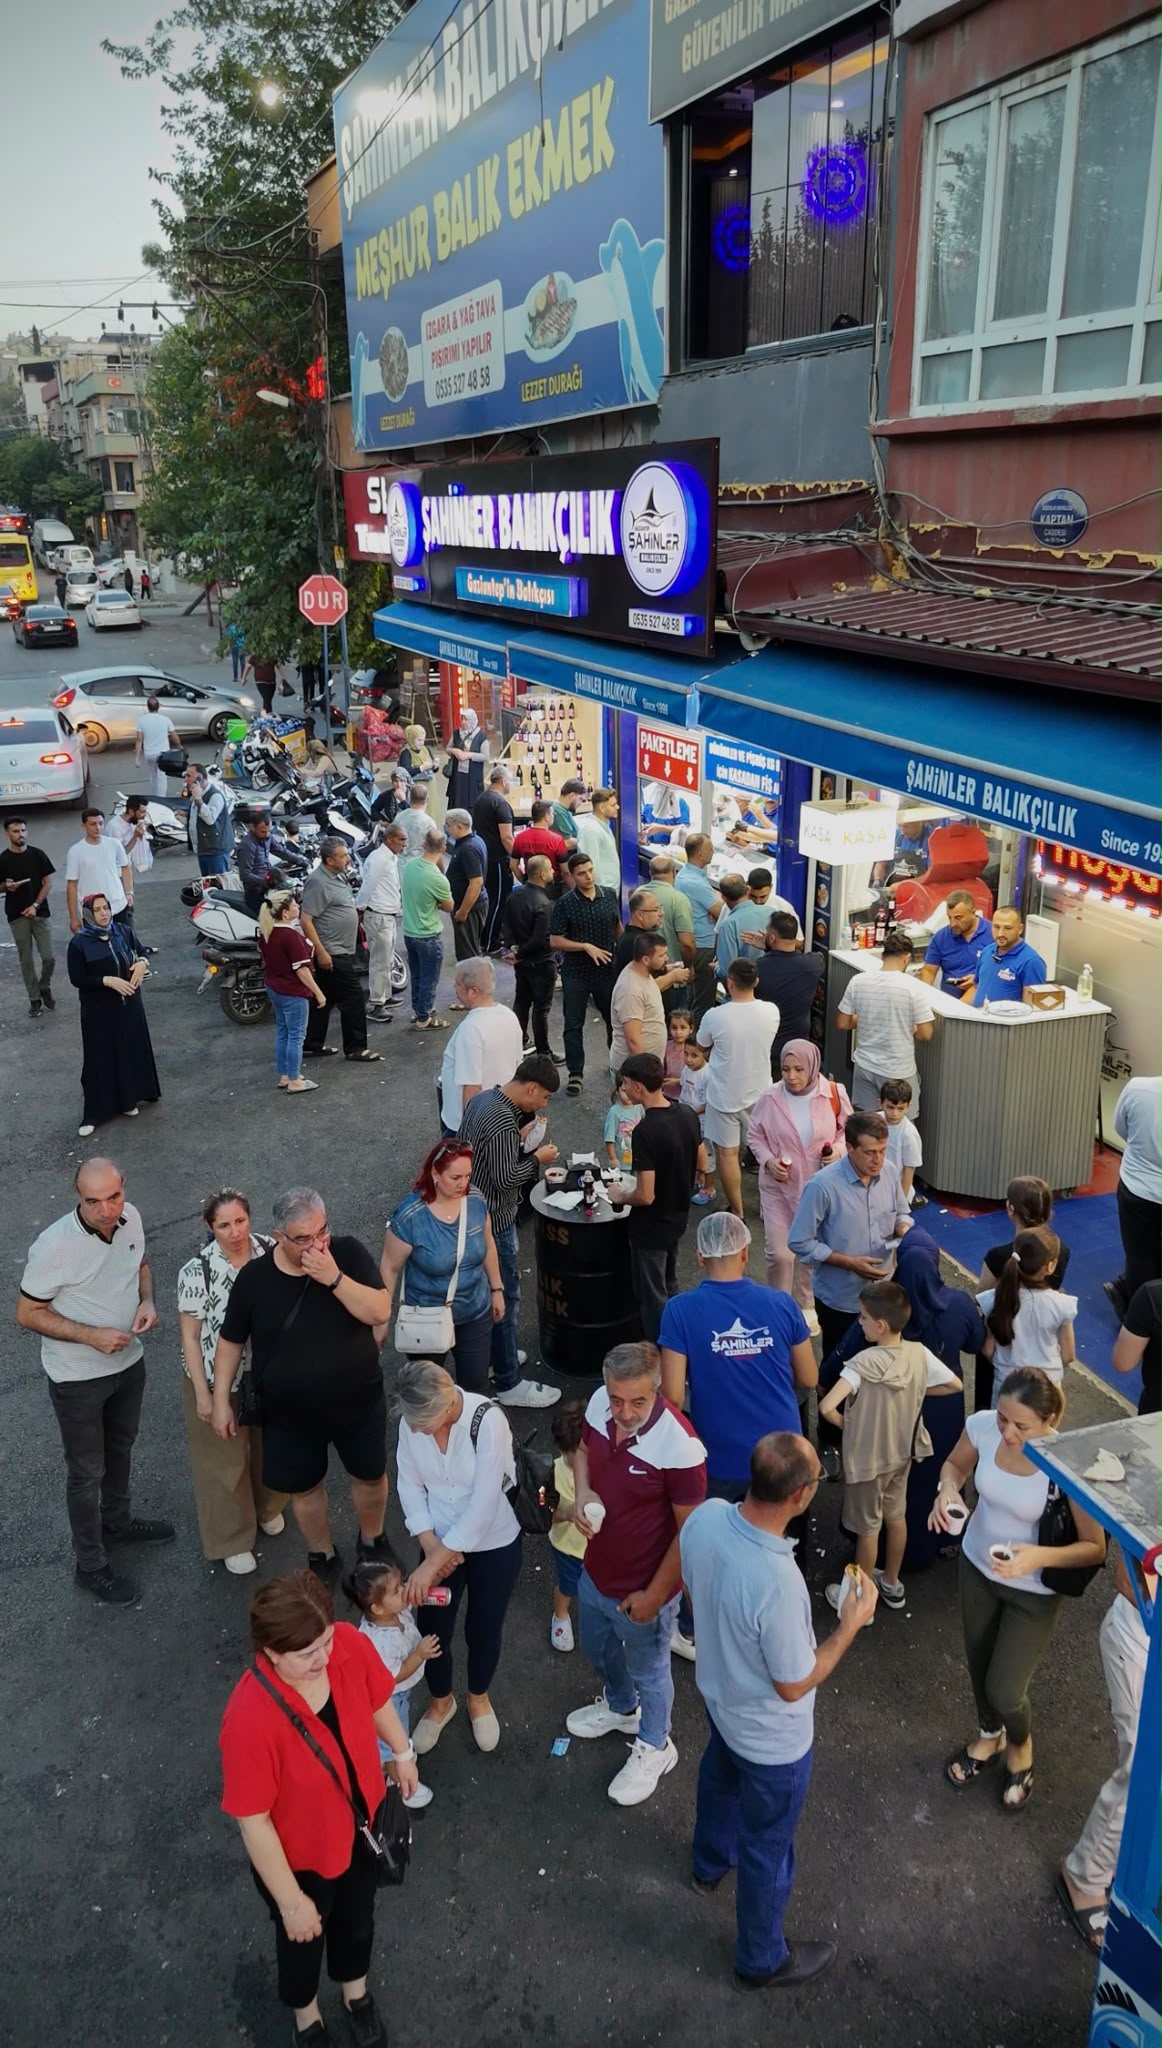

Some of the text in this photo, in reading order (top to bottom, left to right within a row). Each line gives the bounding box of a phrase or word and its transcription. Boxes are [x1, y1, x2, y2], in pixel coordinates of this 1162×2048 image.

[355, 75, 615, 302] MEŞHUR BALIK EKMEK
[425, 295, 496, 342] IZGARA & YAĞ TAVA
[462, 331, 492, 359] YAPILIR
[435, 366, 491, 400] 0535 527 48 58
[521, 363, 583, 402] LEZZET DURAĞI
[498, 490, 616, 564] BALIKÇILIK
[303, 590, 343, 610] DUR
[632, 613, 680, 632] 0535 527 48 58
[603, 680, 637, 708] BALIKÇILIK
[642, 697, 656, 711] Since
[640, 731, 697, 764] PAKETLEME
[804, 823, 888, 846] KASA KASA
[982, 782, 1078, 837] BALIKÇILIK
[1101, 829, 1139, 857] Since
[1143, 841, 1162, 864] 19
[471, 1405, 486, 1437] GUESS
